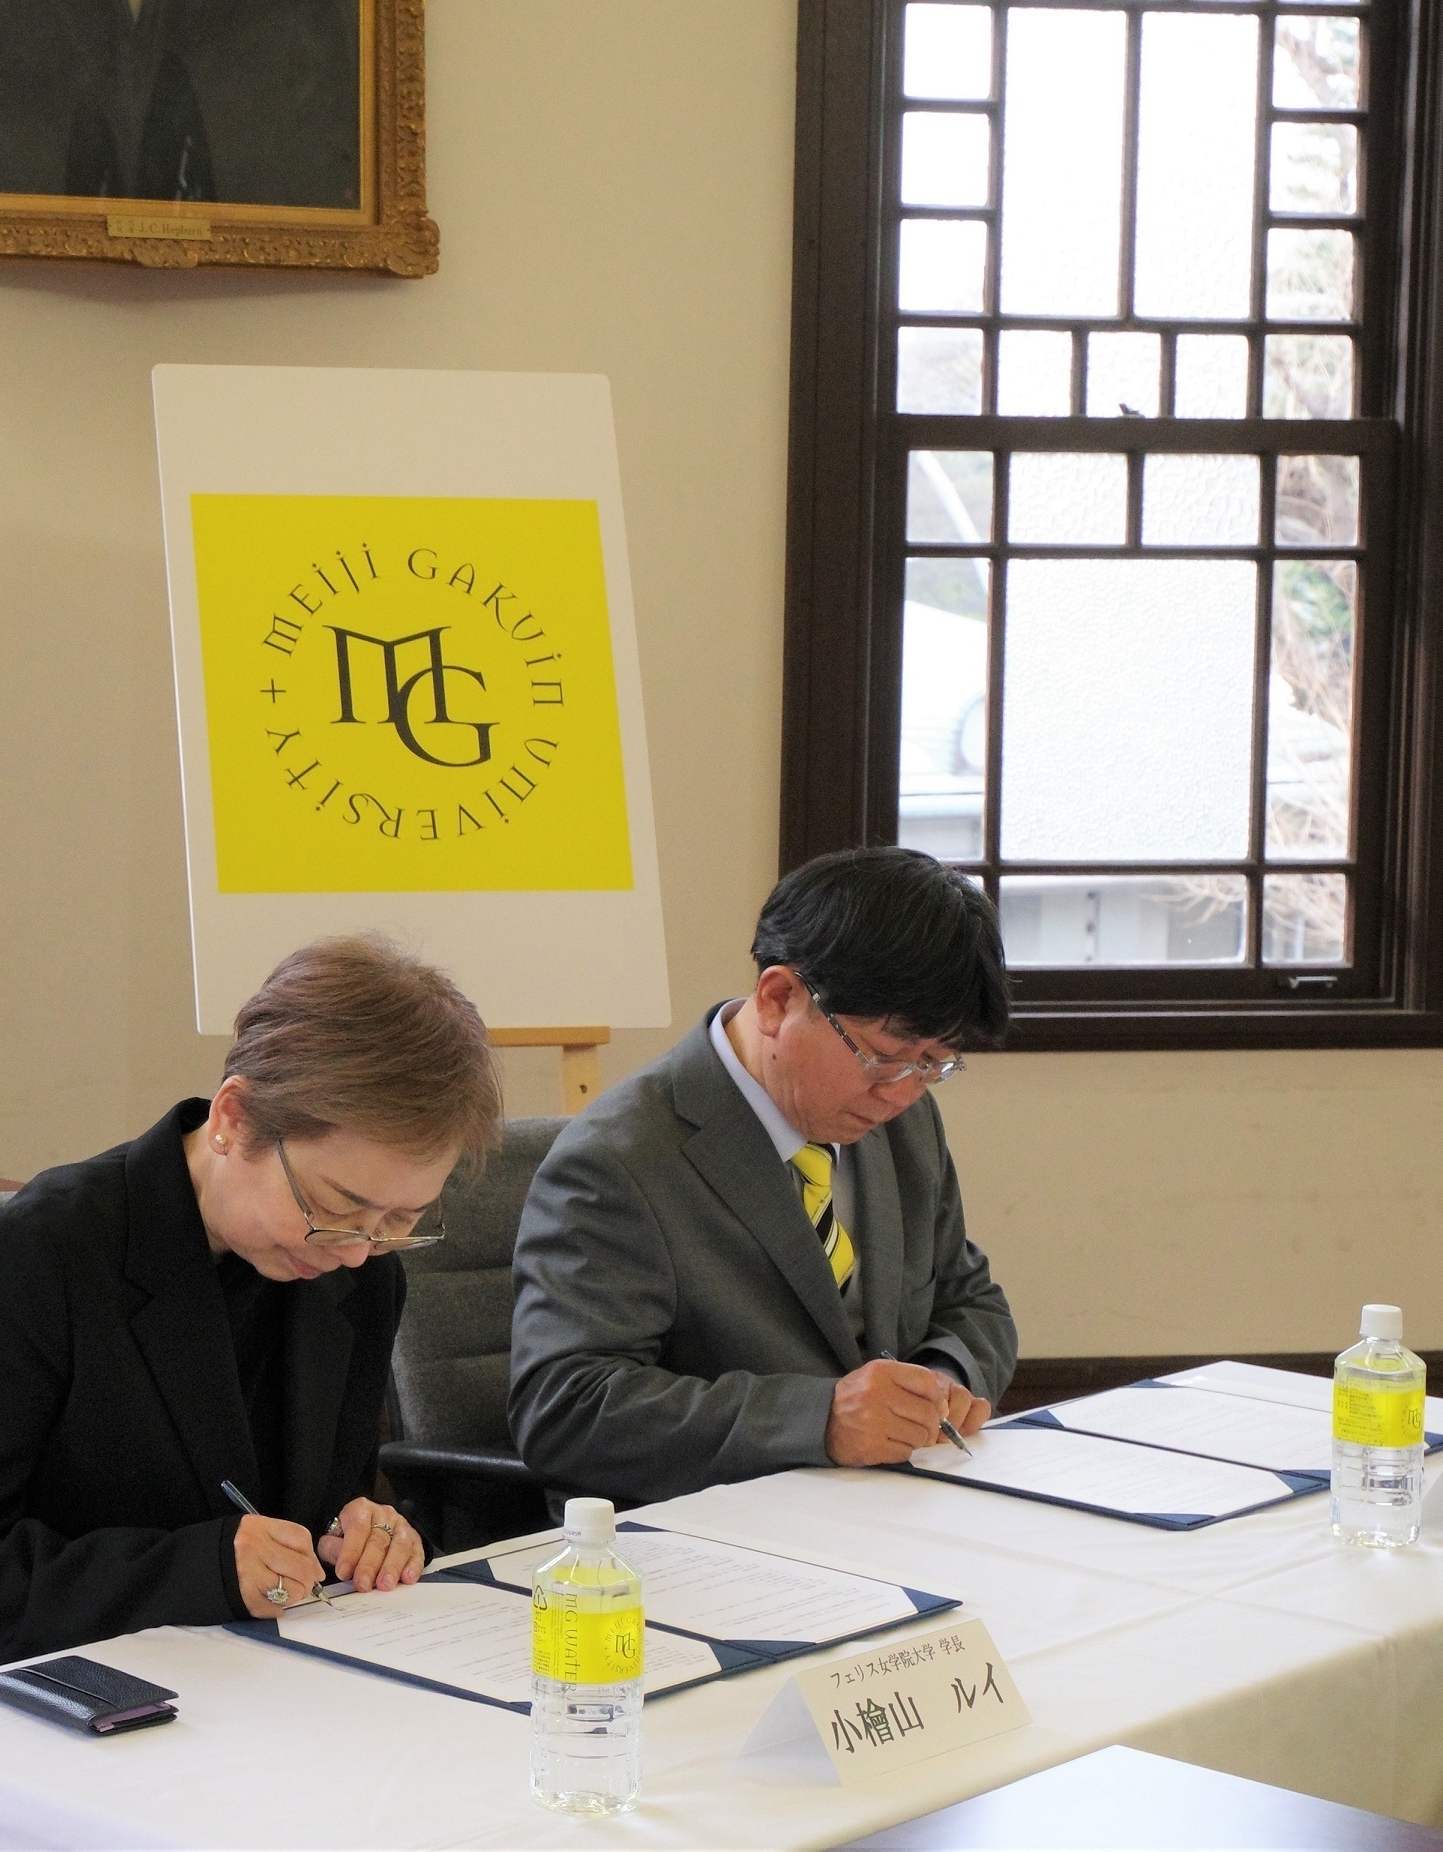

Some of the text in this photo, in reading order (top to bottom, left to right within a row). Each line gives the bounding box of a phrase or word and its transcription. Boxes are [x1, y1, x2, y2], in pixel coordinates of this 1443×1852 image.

[322, 624, 501, 768] MG
[829, 1634, 966, 1689] フェリス女学院大学 学長
[831, 1661, 1004, 1754] 小檜山 ルイ
